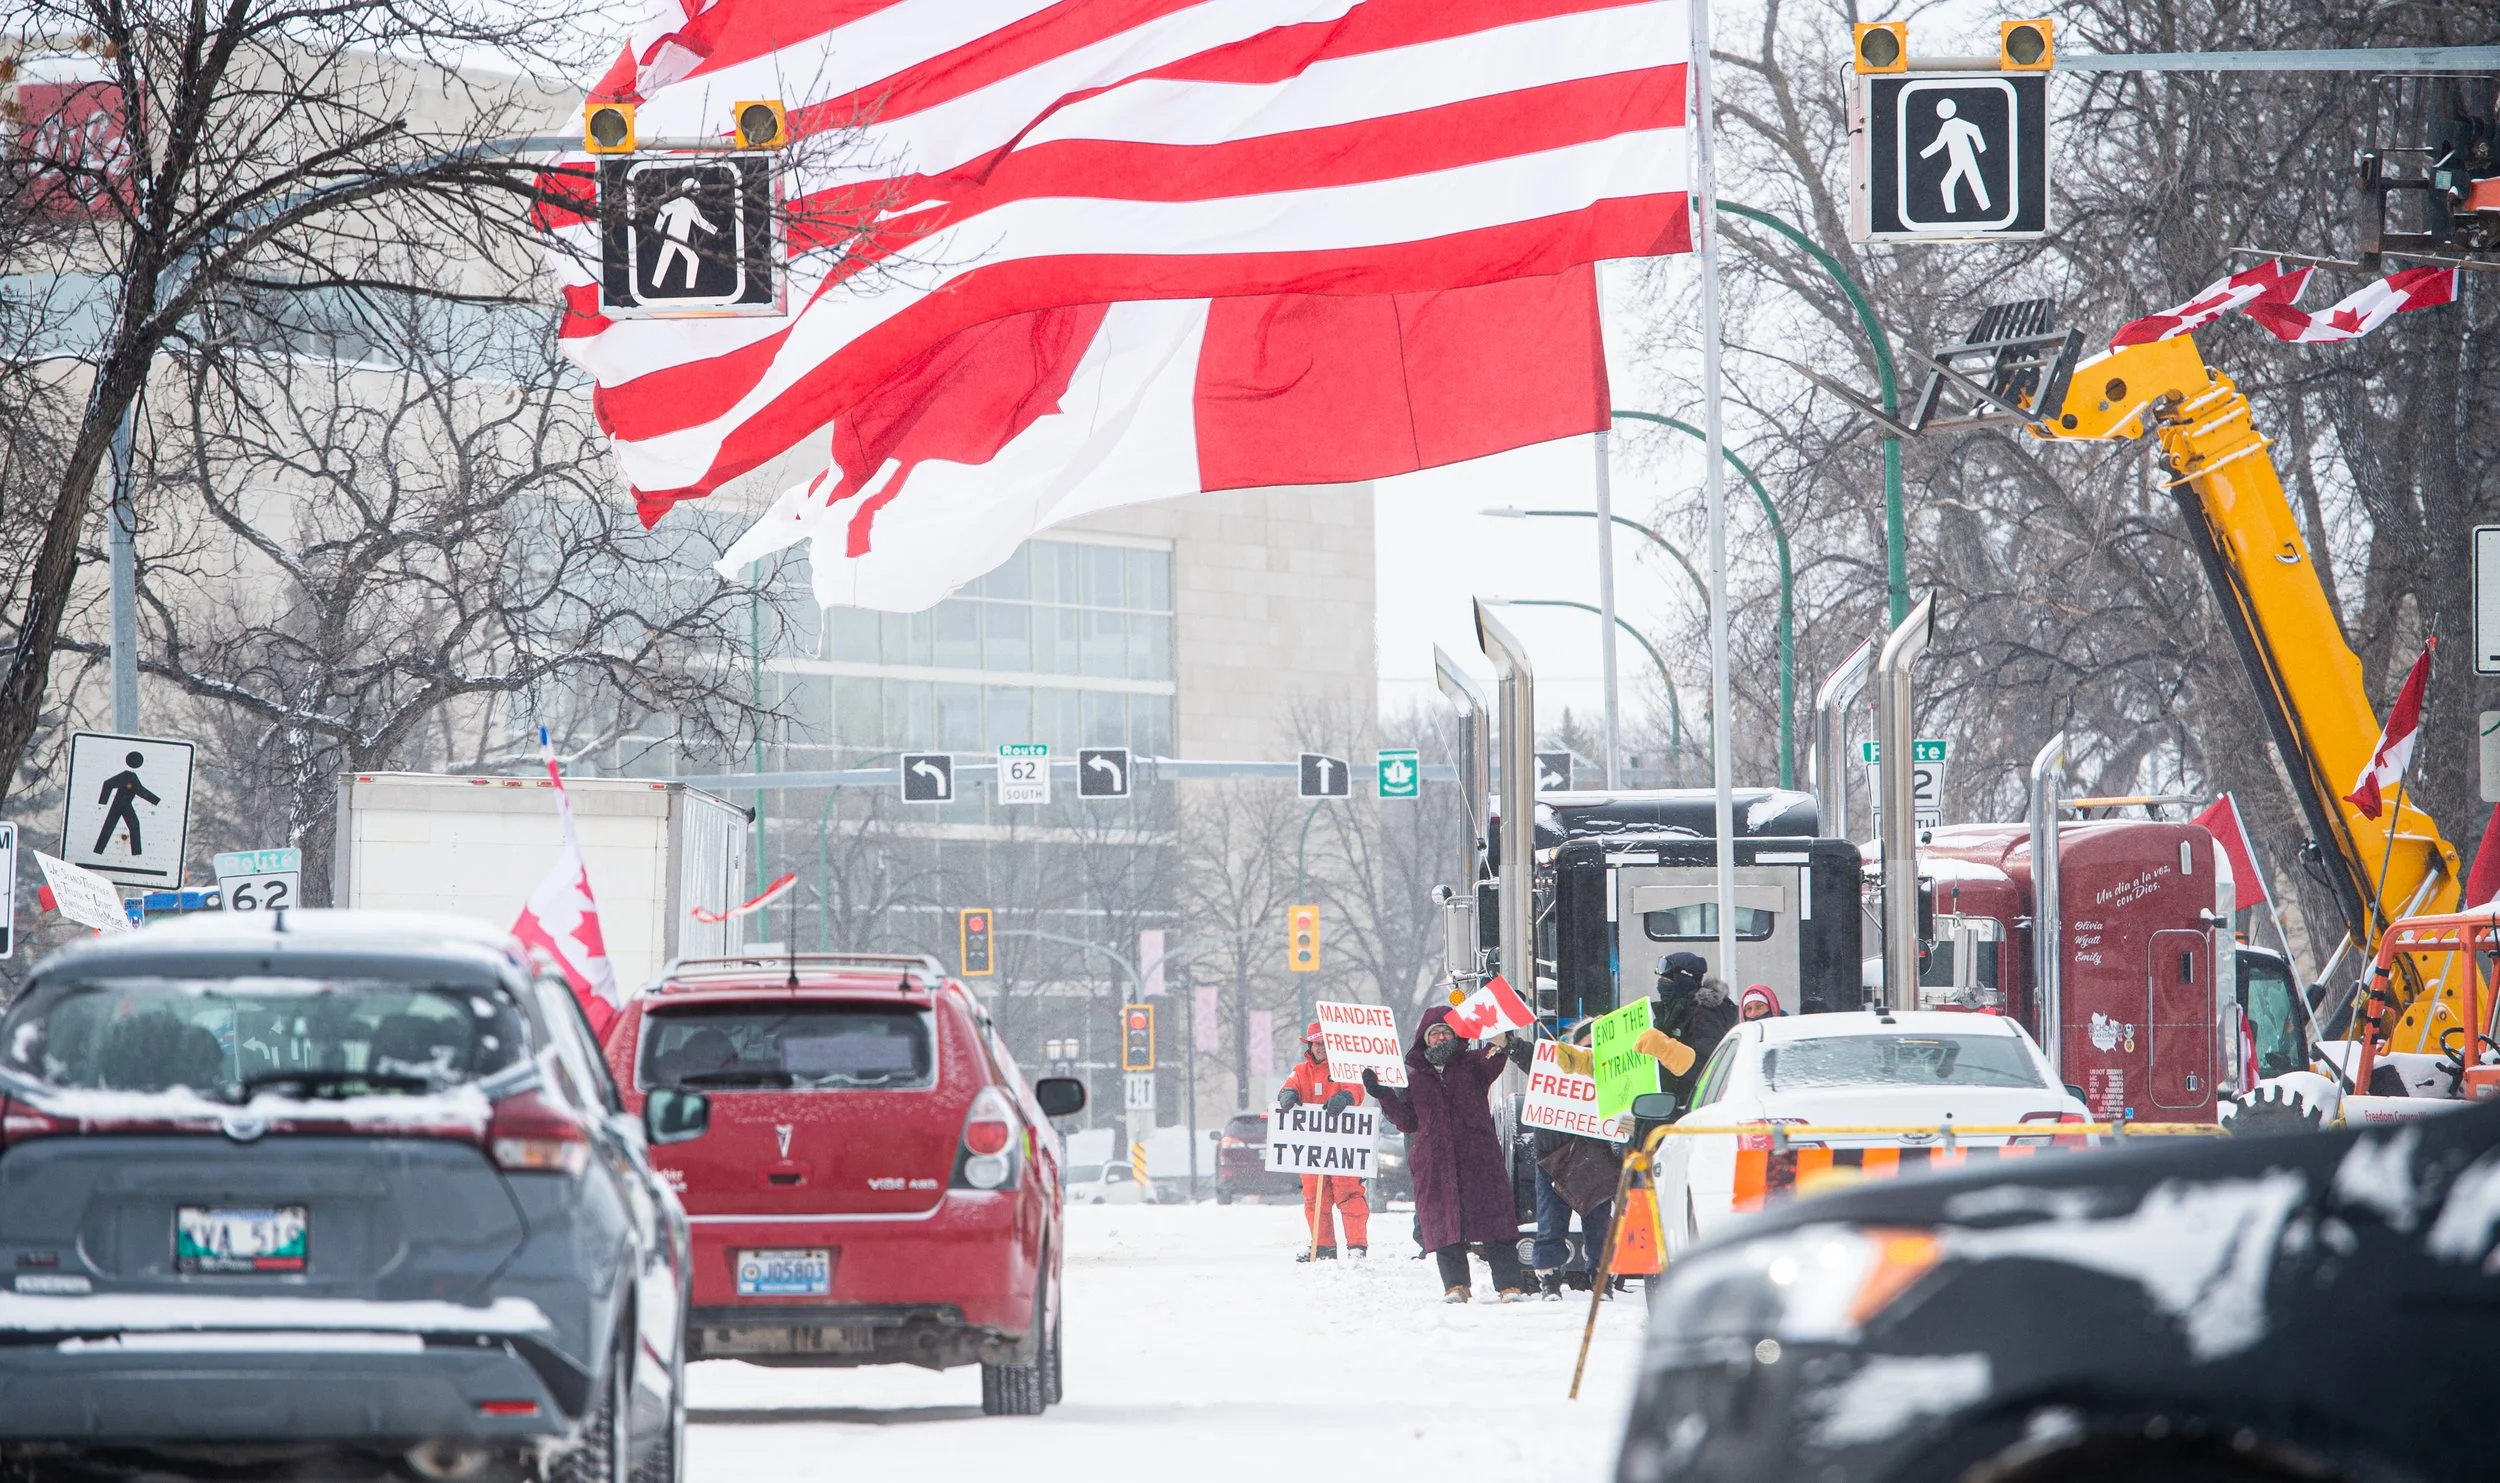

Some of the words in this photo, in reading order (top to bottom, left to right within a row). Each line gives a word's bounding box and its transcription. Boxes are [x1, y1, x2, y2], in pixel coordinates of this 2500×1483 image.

[1002, 745, 1044, 756] Route
[1870, 743, 1940, 759] Rte
[1011, 762, 1036, 780] 62
[1006, 790, 1042, 800] SOUTH
[1914, 770, 1933, 800] 2
[224, 853, 292, 869] Route
[232, 880, 289, 911] 62
[2096, 889, 2112, 905] Un
[2115, 882, 2130, 896] dia
[2133, 878, 2139, 887] a
[2142, 872, 2151, 884] la
[2116, 895, 2133, 907] con
[2132, 882, 2160, 899] Dios.
[2074, 921, 2103, 930] Olivia
[2074, 934, 2101, 948] Wyatt
[2074, 951, 2102, 965] Emily
[1320, 1005, 1393, 1027] MANDATE
[1595, 1021, 1615, 1046] END
[1624, 1007, 1645, 1033] THE
[1325, 1033, 1399, 1056] FREEDOM
[1531, 1074, 1596, 1102] FREED
[1526, 1104, 1626, 1139] MBFREE.CA
[2364, 1110, 2394, 1122] Freedom
[1273, 1143, 1370, 1170] TYRANT
